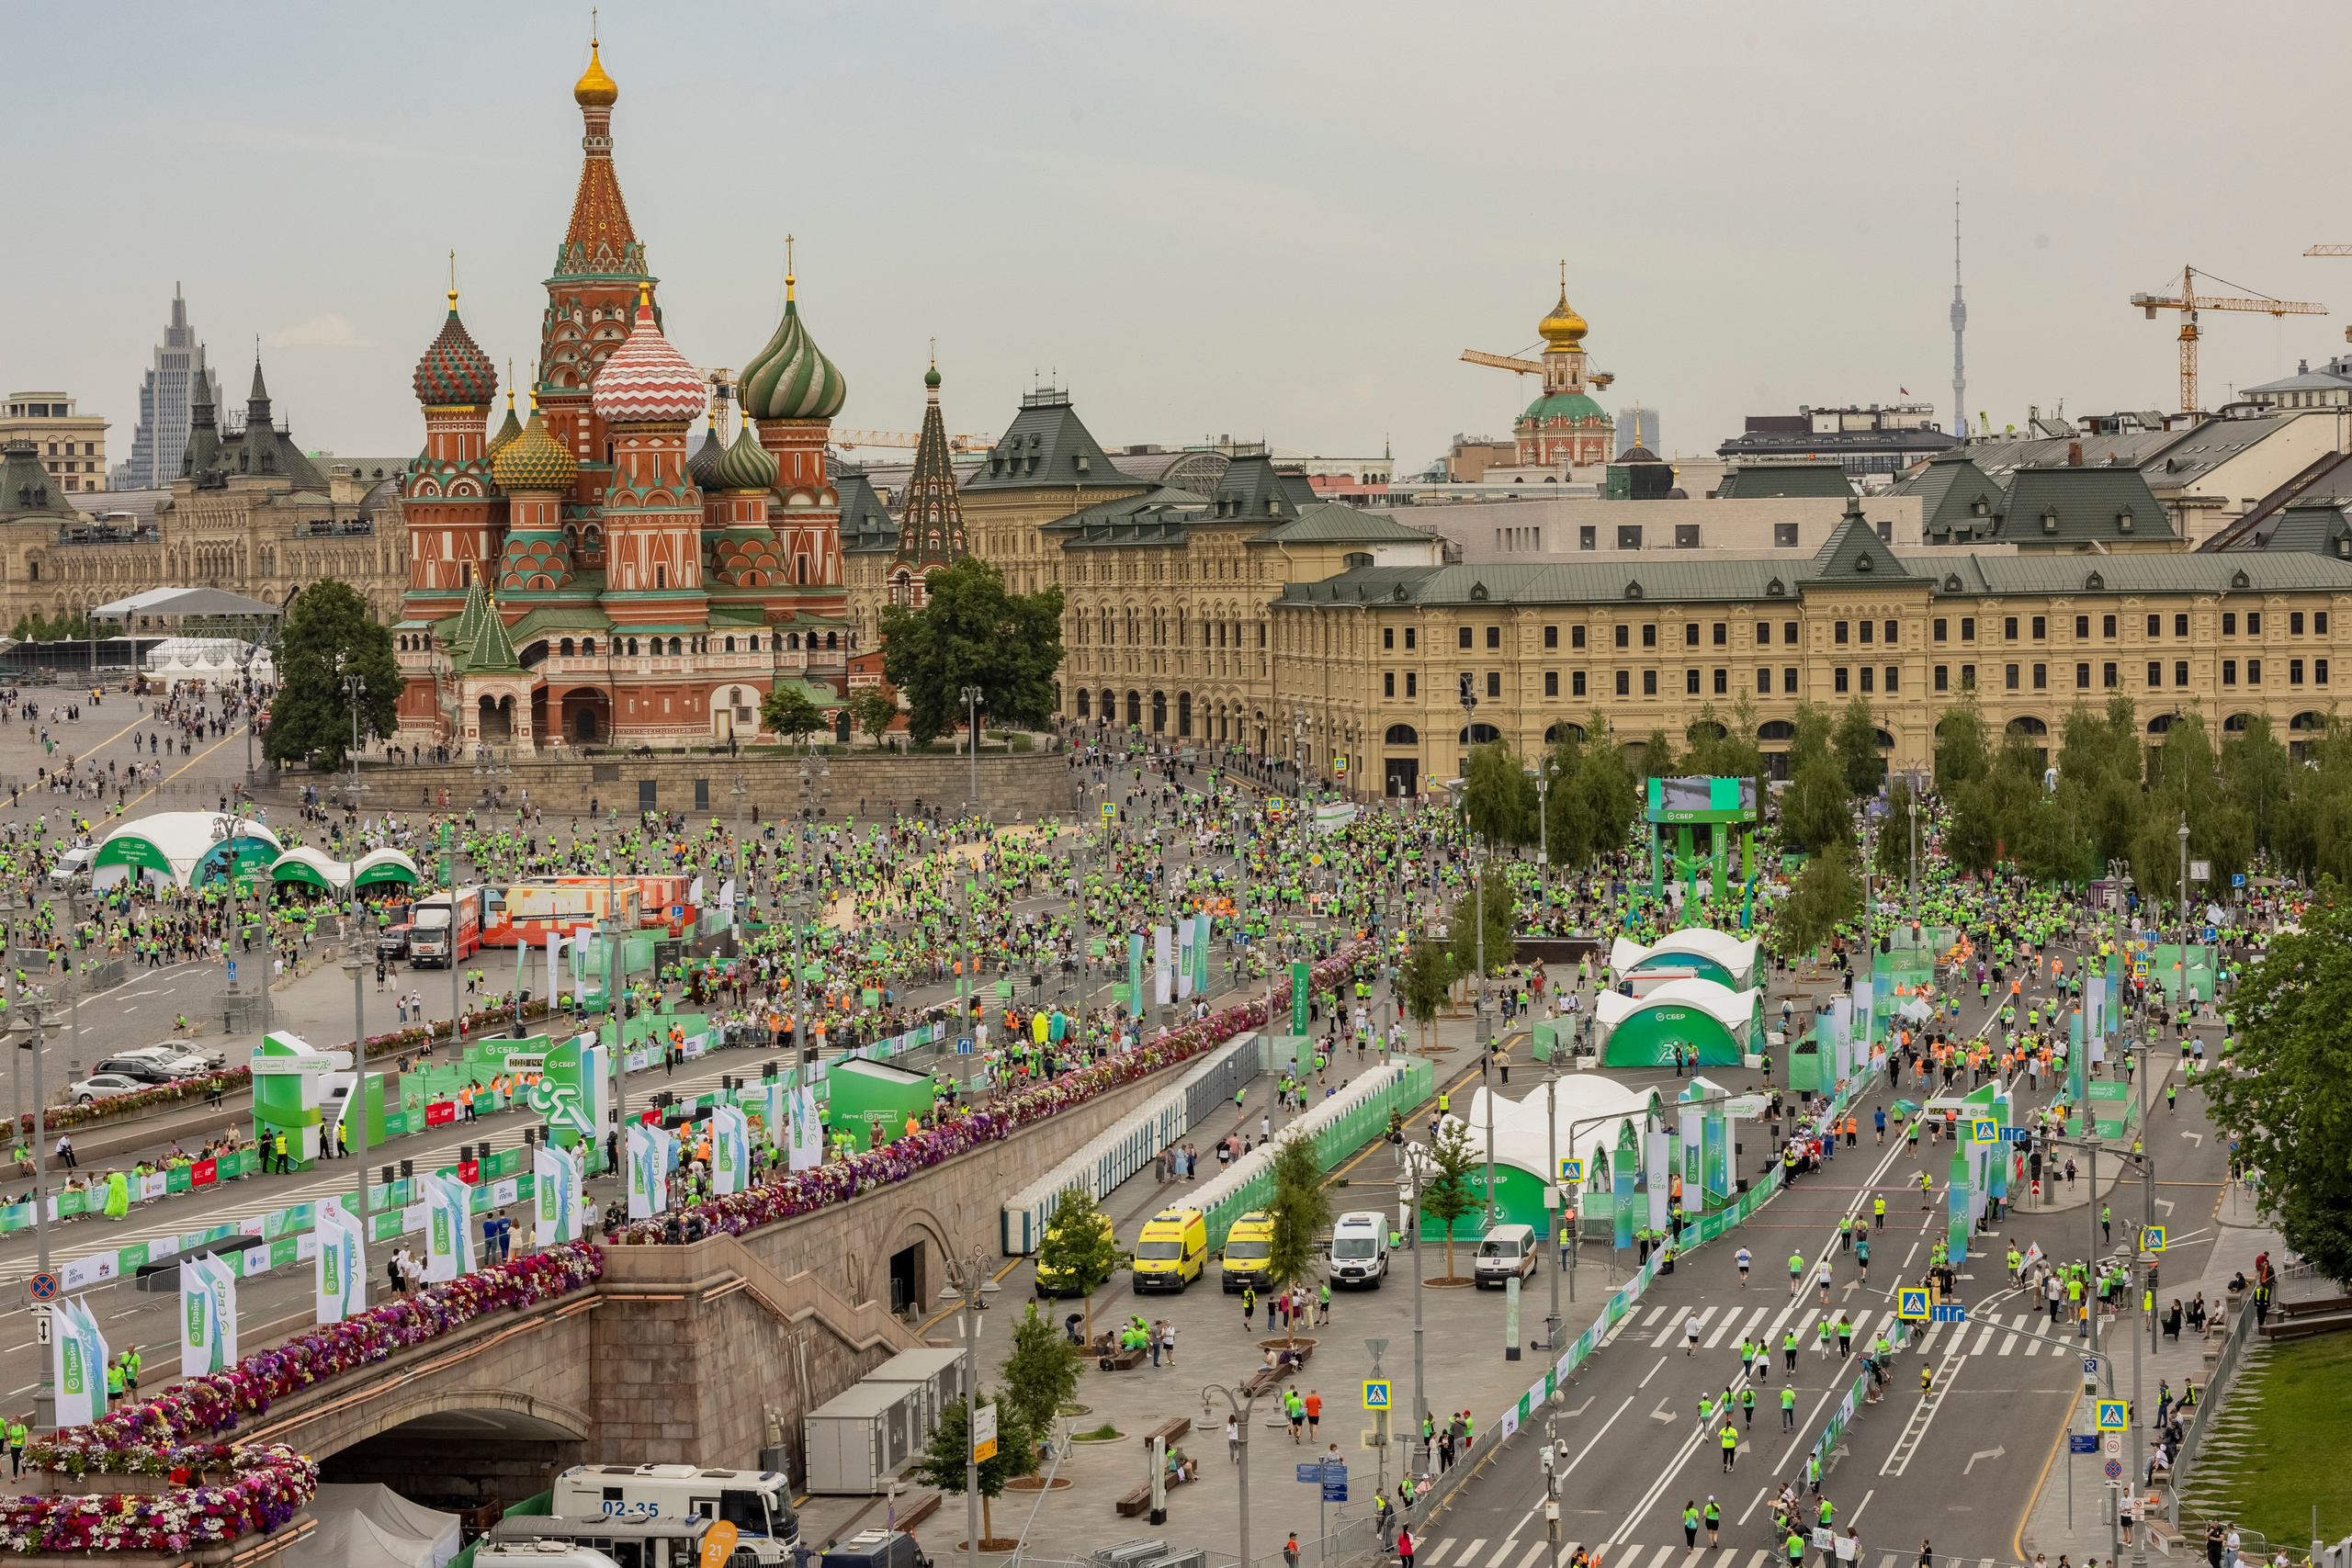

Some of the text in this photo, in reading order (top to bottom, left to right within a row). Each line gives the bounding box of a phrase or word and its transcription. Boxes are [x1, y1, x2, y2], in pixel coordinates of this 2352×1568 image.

[92, 1188, 107, 1201] БЕГИ
[271, 1214, 283, 1227] БЕГИ
[188, 1234, 202, 1248] БЕГИ
[69, 1269, 77, 1277] ЭКО-
[217, 1280, 226, 1316] СБЕР
[191, 1298, 200, 1330] Прайм
[69, 1342, 77, 1376] Прайм
[2087, 1361, 2095, 1371] P
[602, 1500, 659, 1518] 02-35
[708, 1544, 722, 1557] 21
